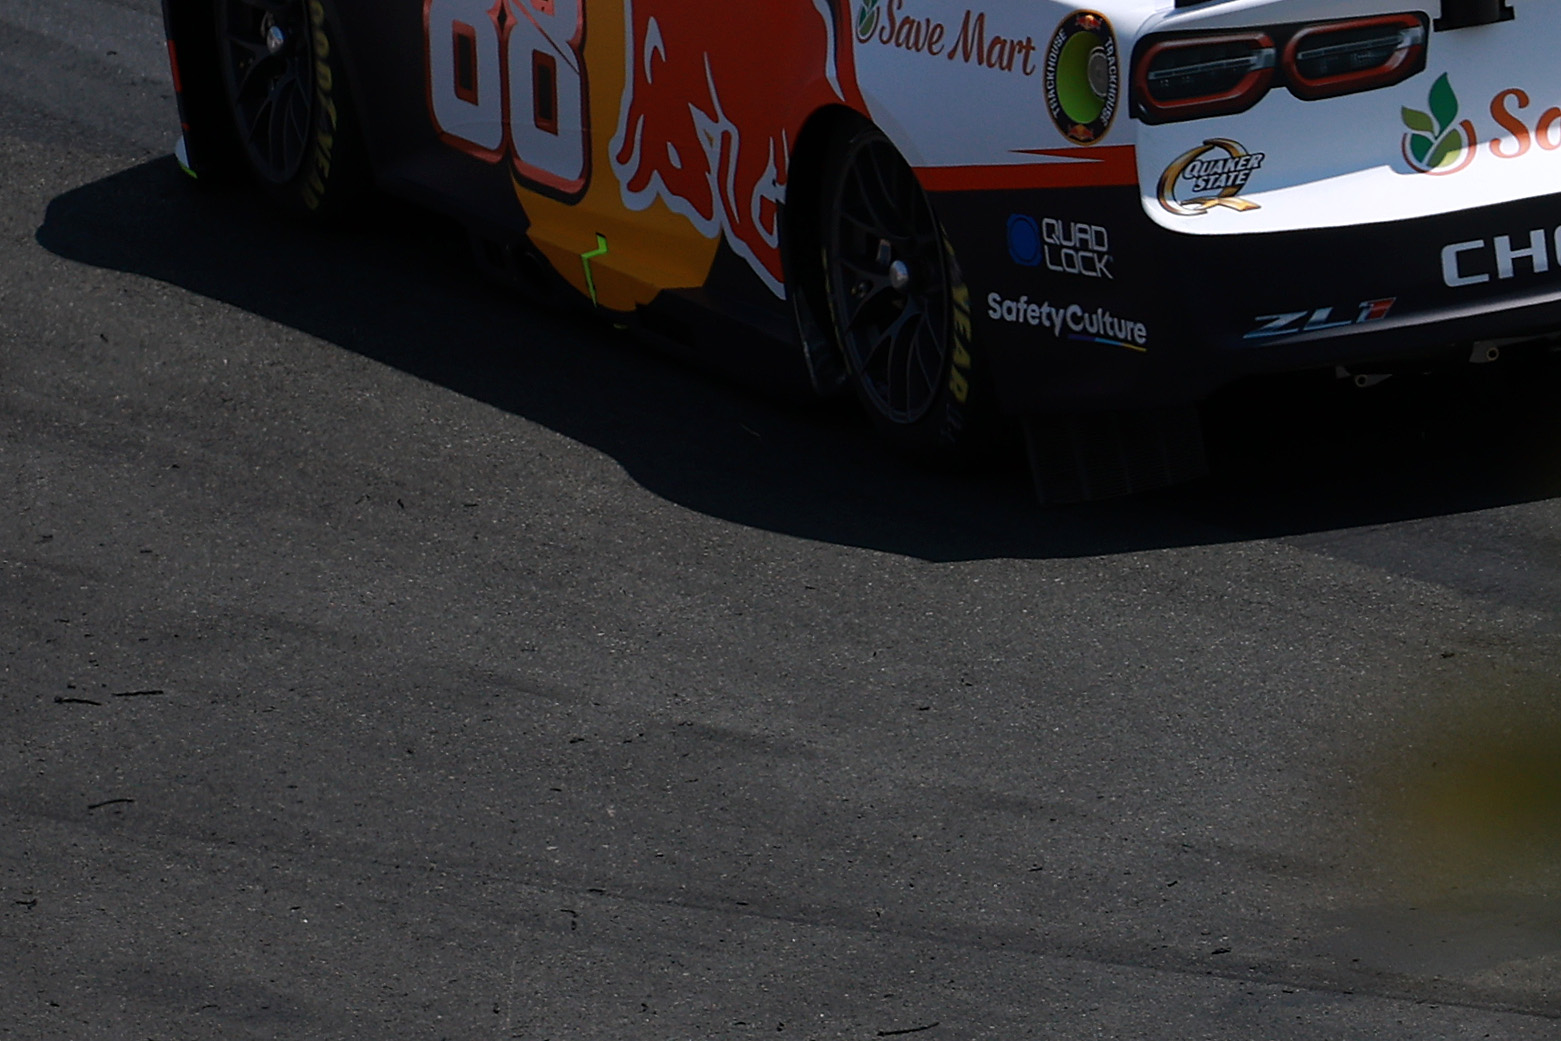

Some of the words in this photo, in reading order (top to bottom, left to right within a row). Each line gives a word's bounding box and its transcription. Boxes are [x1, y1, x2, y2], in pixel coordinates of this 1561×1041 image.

[947, 10, 1036, 76] Mart
[1046, 28, 1068, 119] TRACKHOUSE
[1101, 36, 1118, 127] TRACKHOUSE
[1182, 152, 1265, 180] QUAKER
[1193, 170, 1250, 193] STATE
[1042, 218, 1109, 253] QUAD
[1043, 245, 1114, 279] LOCK
[987, 292, 1148, 345] SafetyCulture
[1242, 296, 1397, 339] ZL1
